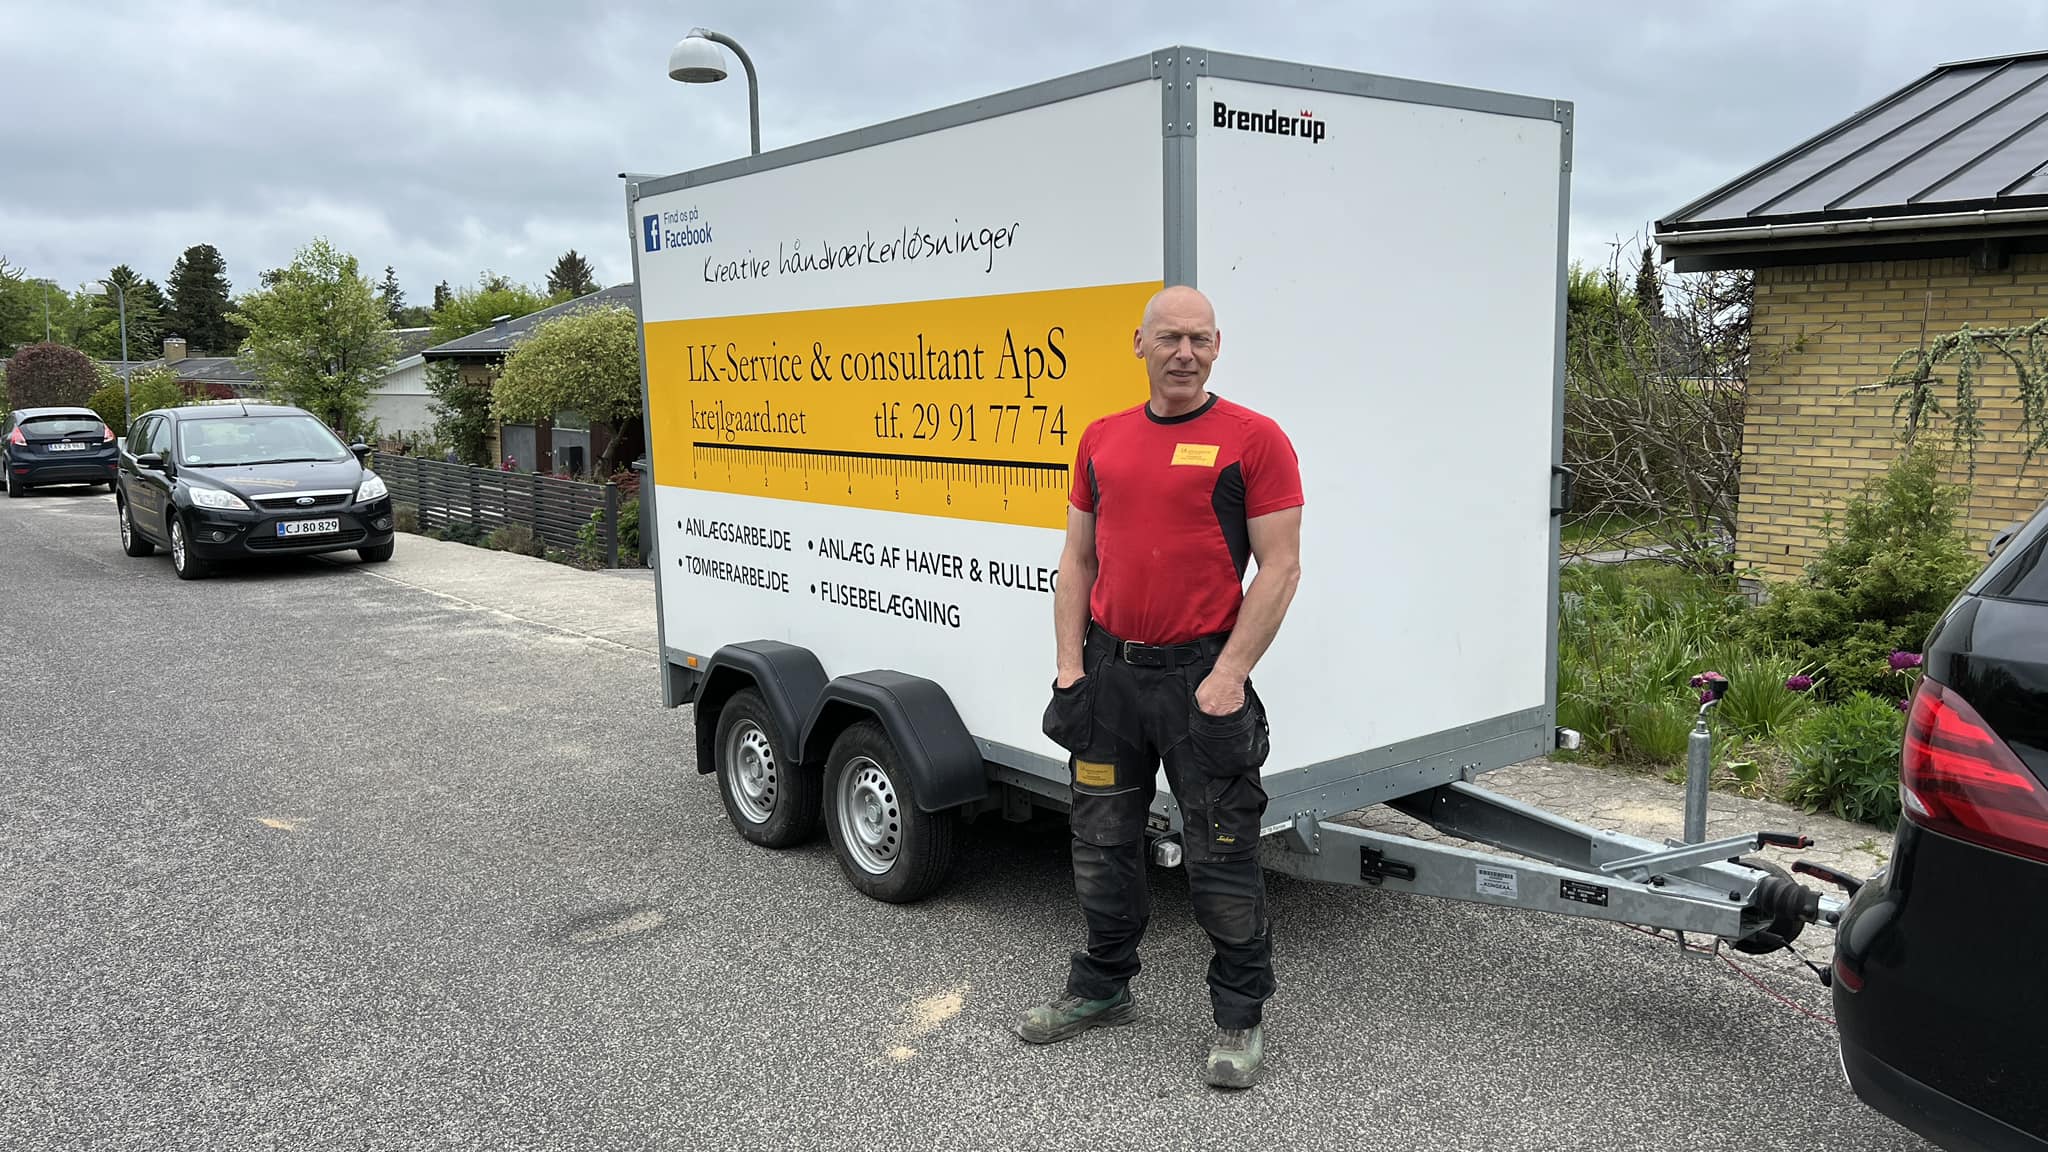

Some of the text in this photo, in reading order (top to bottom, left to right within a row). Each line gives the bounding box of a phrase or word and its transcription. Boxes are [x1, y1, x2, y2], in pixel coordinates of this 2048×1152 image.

[1213, 101, 1325, 144] Brenderup
[664, 204, 699, 225] Find os på
[665, 221, 713, 248] Facebook
[704, 218, 1020, 283] Kreative håndværkerløsninger
[687, 326, 1067, 398] LK-Service & consultant ApS
[690, 400, 807, 442] krejlgaard.net
[874, 402, 1068, 446] tlf. 29 91 77 74
[946, 494, 952, 505] 6
[1003, 499, 1008, 511] 7
[286, 520, 337, 533] CJ 80 829
[686, 517, 792, 551] ANLÆGSARBEJDE
[685, 555, 790, 593] TØMRERARBEJDE
[819, 537, 875, 565] ANLÆG
[880, 546, 900, 568] AF
[906, 549, 963, 580] HAVER
[969, 558, 983, 582] &
[821, 581, 961, 628] FLISEBELÆGNING
